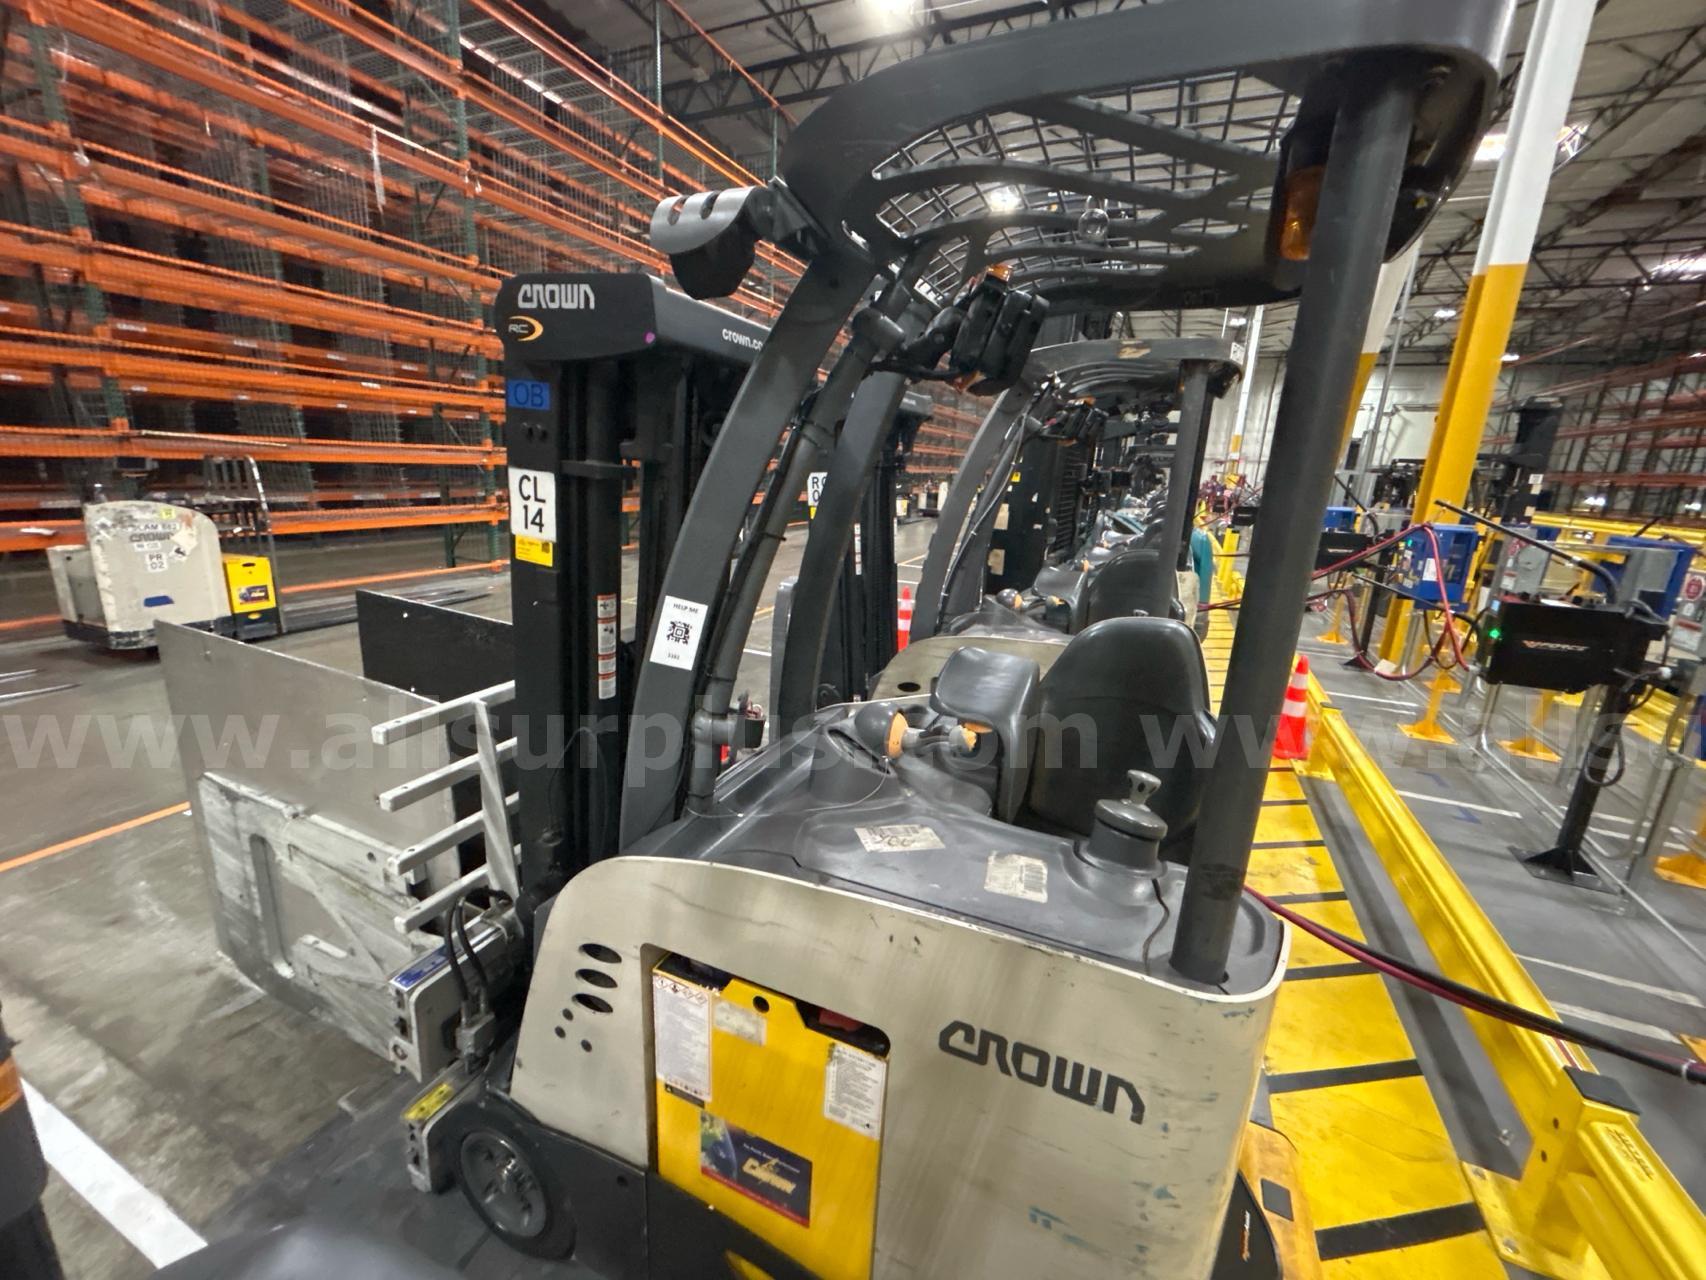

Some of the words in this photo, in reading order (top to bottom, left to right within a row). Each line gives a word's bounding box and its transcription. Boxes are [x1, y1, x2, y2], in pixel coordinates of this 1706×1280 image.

[517, 283, 595, 310] CROWN
[508, 323, 529, 334] RC
[513, 382, 545, 408] OB
[518, 474, 546, 503] CL
[523, 504, 545, 533] 14
[673, 603, 688, 611] HELP
[939, 1020, 1145, 1125] CROWN
